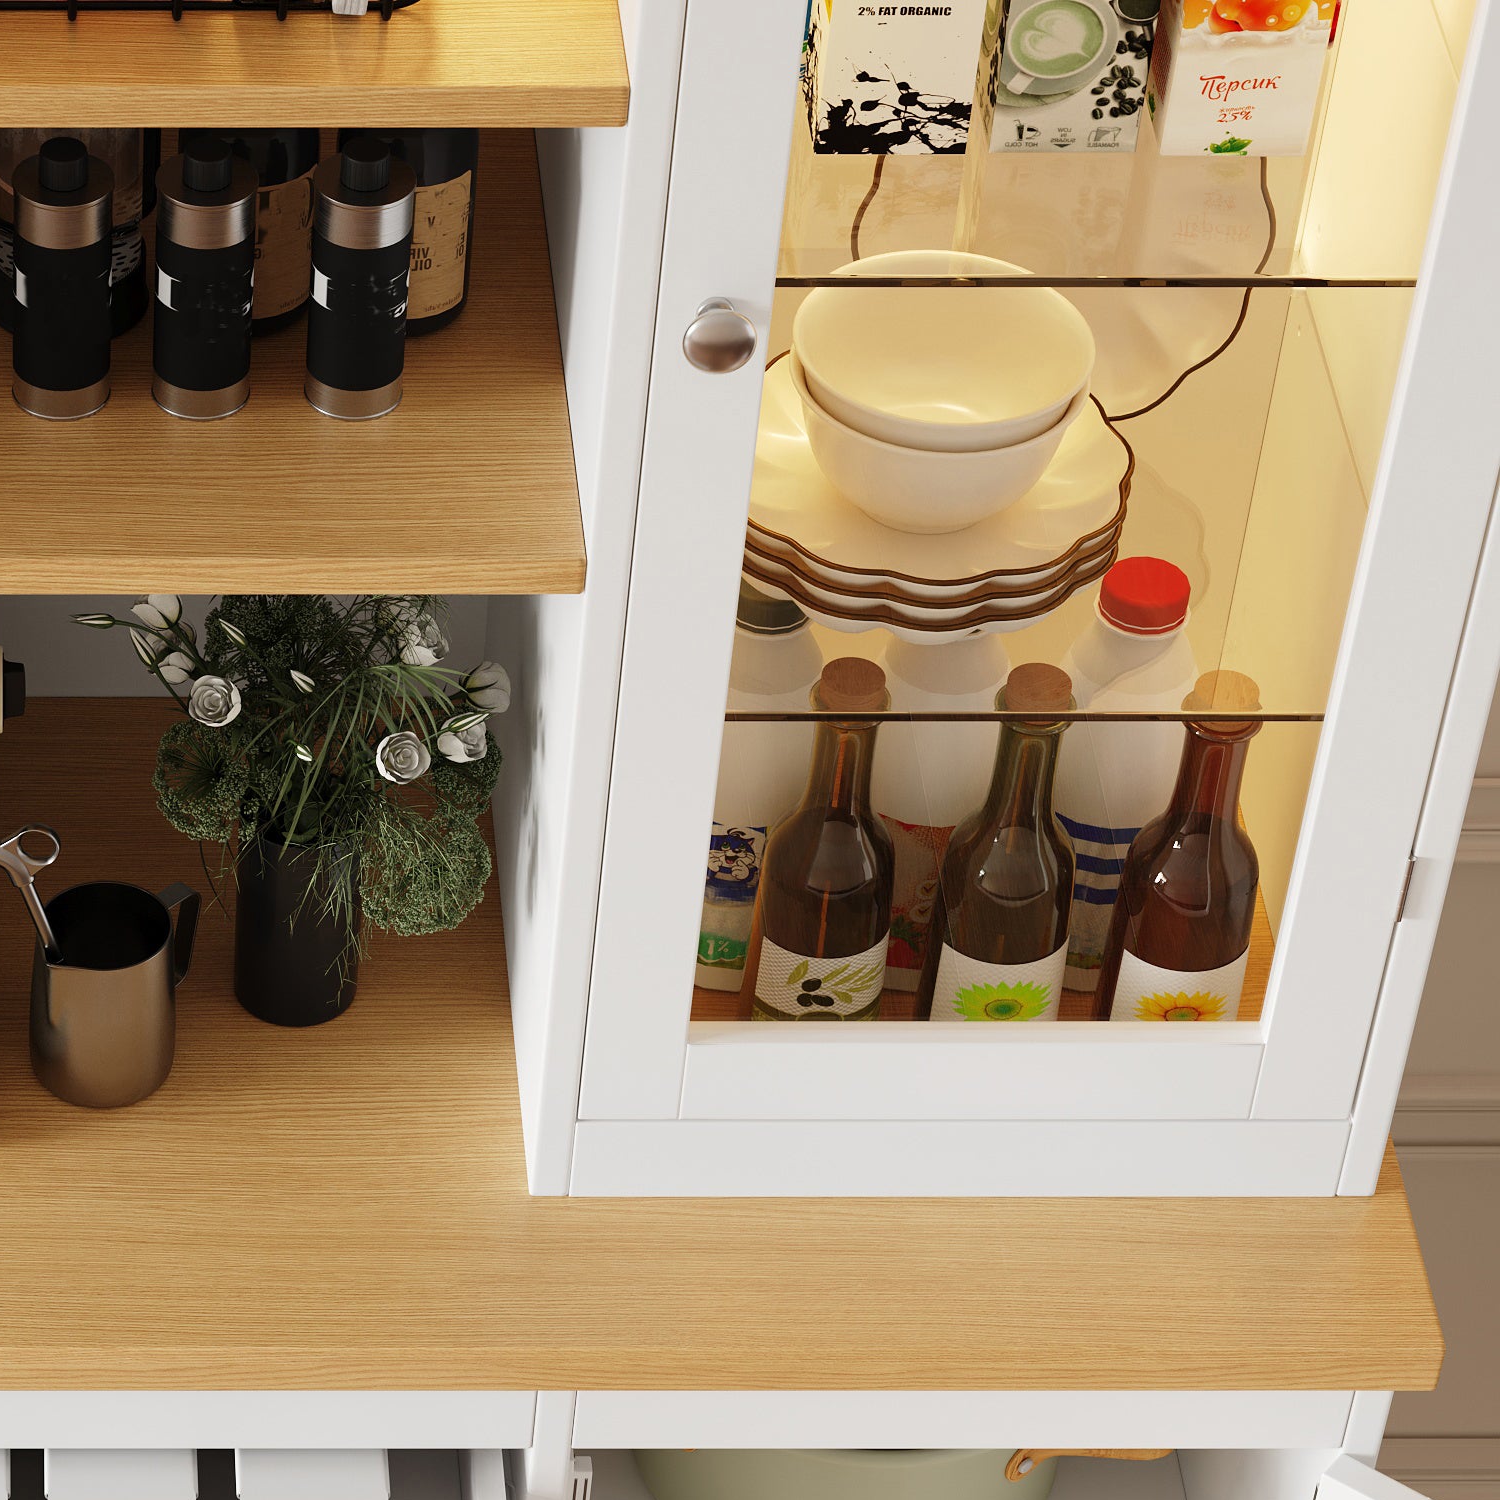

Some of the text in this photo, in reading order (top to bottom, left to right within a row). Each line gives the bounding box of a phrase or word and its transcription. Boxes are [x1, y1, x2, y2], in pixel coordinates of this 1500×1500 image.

[858, 6, 953, 17] 2% FAT ORGANIC
[1199, 75, 1282, 102] Персик
[707, 939, 730, 958] 1%
